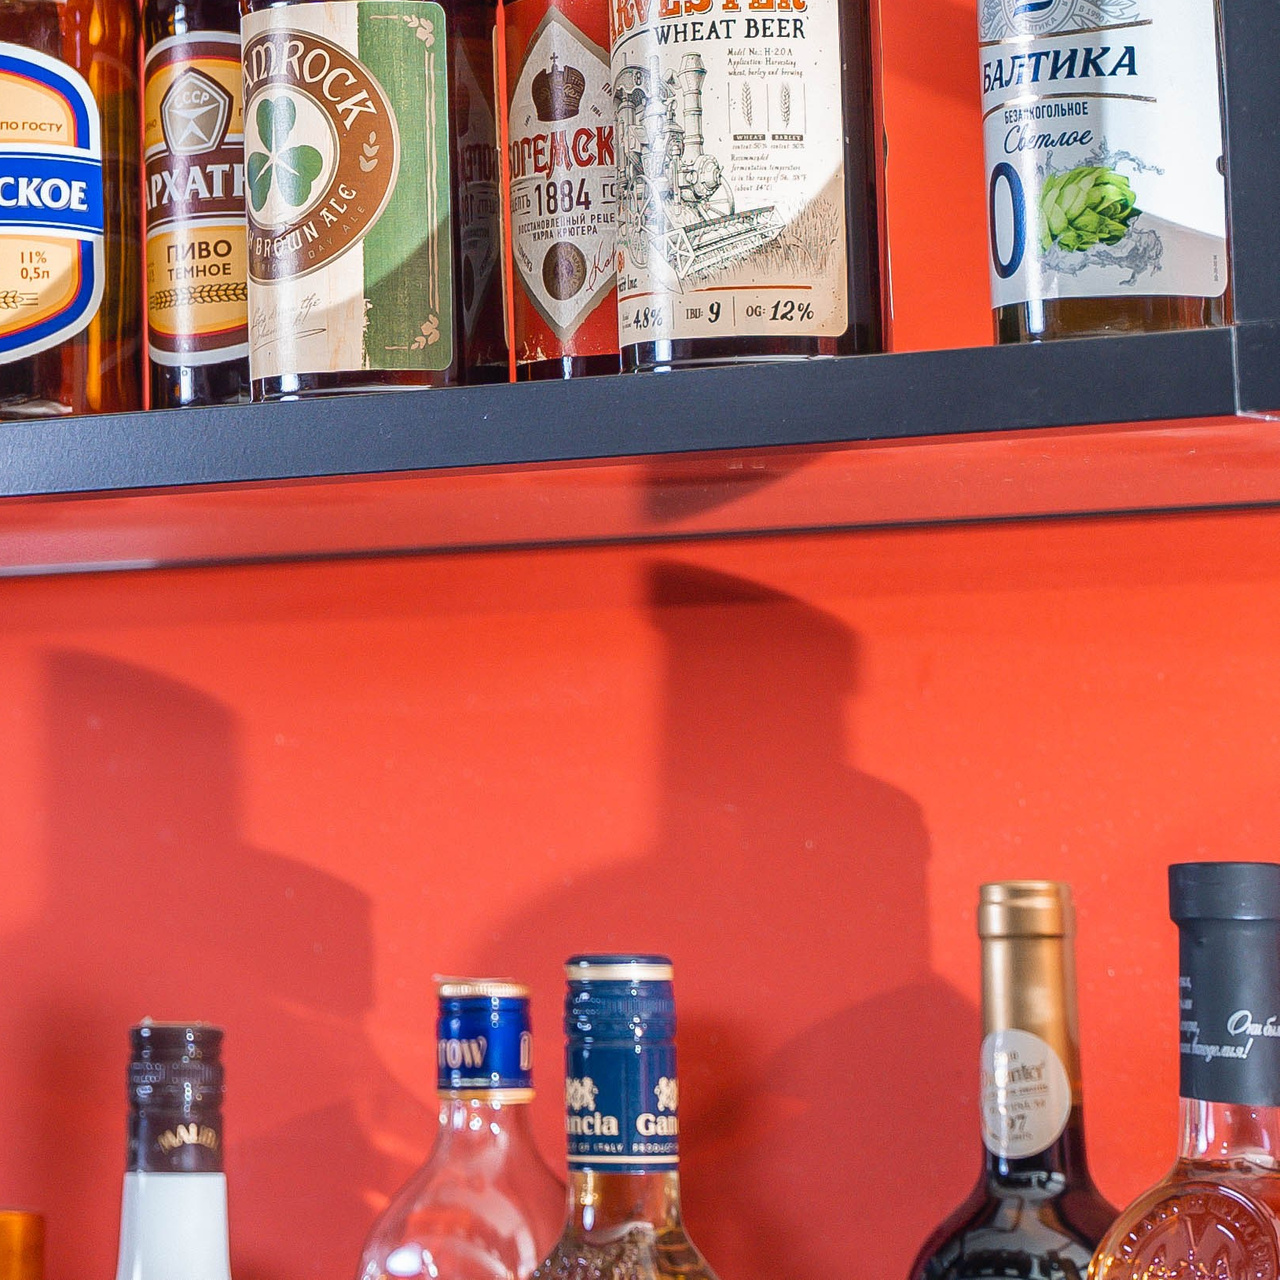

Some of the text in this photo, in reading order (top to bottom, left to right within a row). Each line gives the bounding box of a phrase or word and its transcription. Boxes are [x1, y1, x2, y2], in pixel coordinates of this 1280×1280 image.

[655, 18, 807, 46] WHEAT BEER
[983, 46, 1139, 95] БАЛТИКА
[0, 120, 64, 133] ПО ГОСТУ
[1003, 124, 1094, 154] Светлое
[534, 178, 592, 217] 1884
[342, 205, 366, 235] ALE
[591, 212, 616, 224] РЕЦЕ
[989, 161, 1027, 279] 0
[20, 251, 48, 265] 11%
[166, 239, 232, 264] ПИВО
[20, 267, 51, 282] 0,5л
[167, 262, 232, 281] ТЕМНОЕ
[708, 301, 722, 323] 9
[769, 300, 815, 322] 12%
